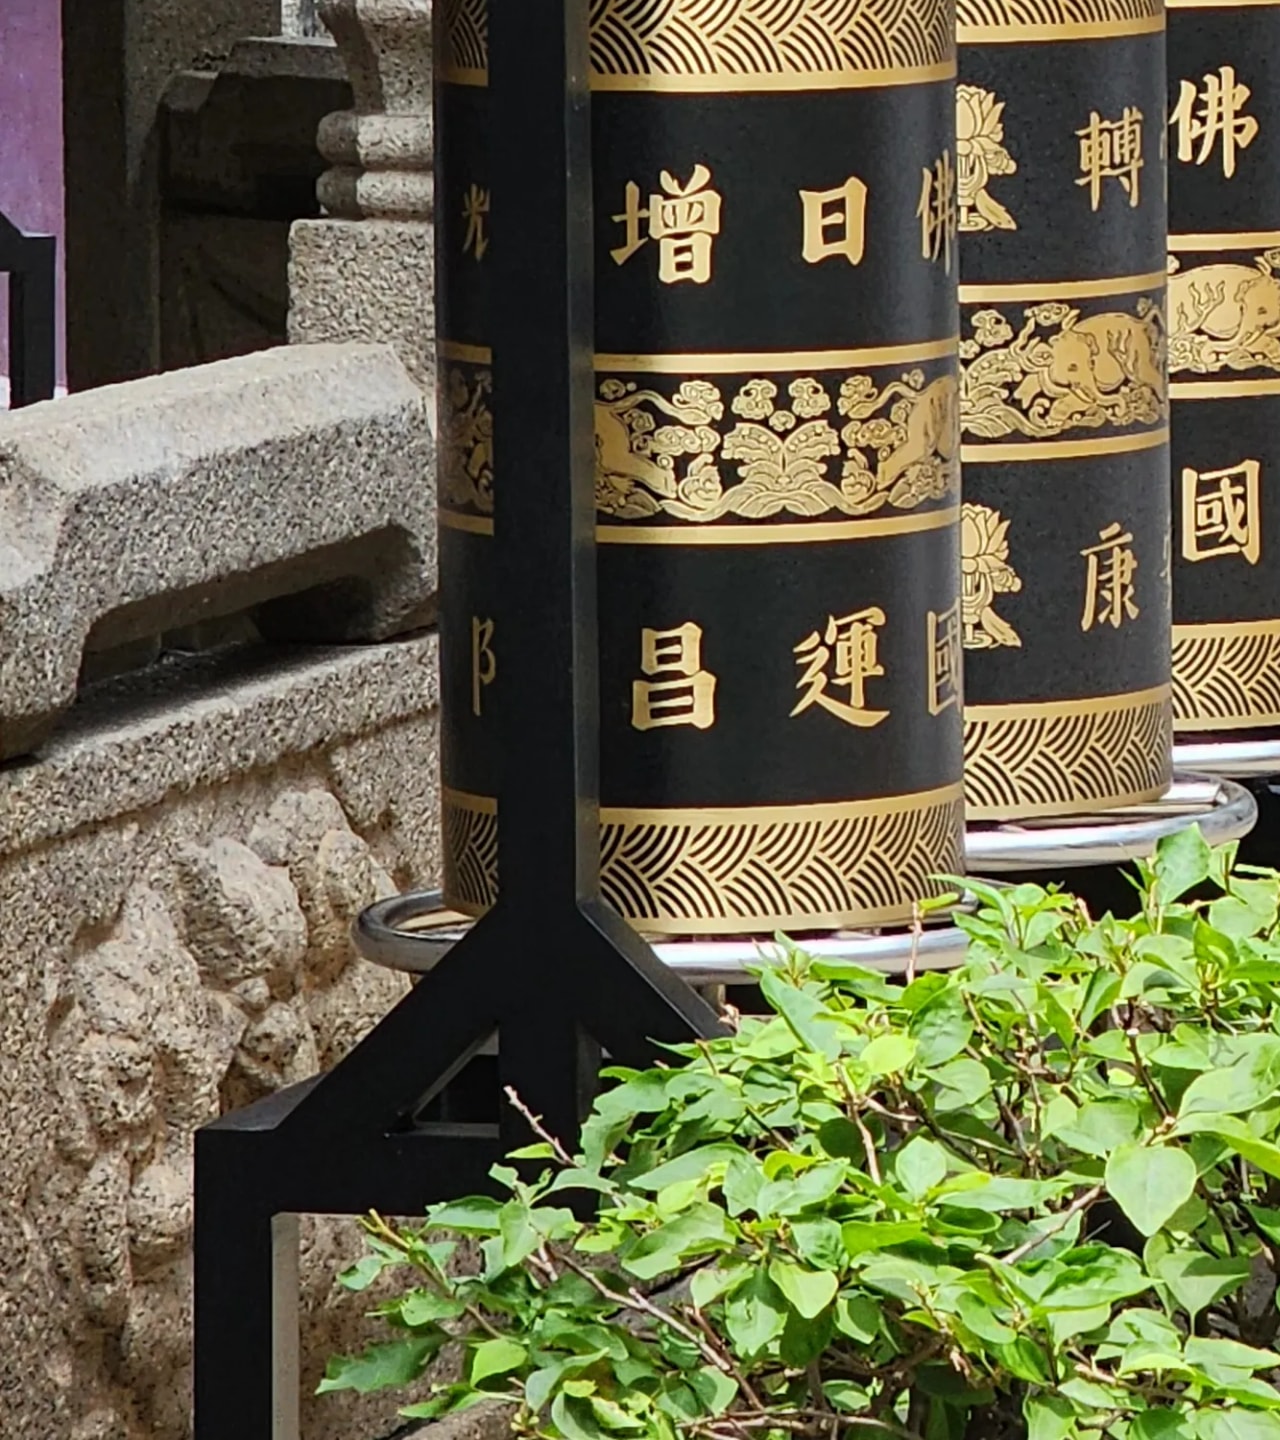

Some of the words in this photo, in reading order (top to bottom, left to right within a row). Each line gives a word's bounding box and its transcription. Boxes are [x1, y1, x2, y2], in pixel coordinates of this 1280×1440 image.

[1074, 106, 1144, 212] 轉
[1168, 65, 1259, 179] 佛
[1182, 458, 1261, 566] 國
[1079, 522, 1140, 632] 康
